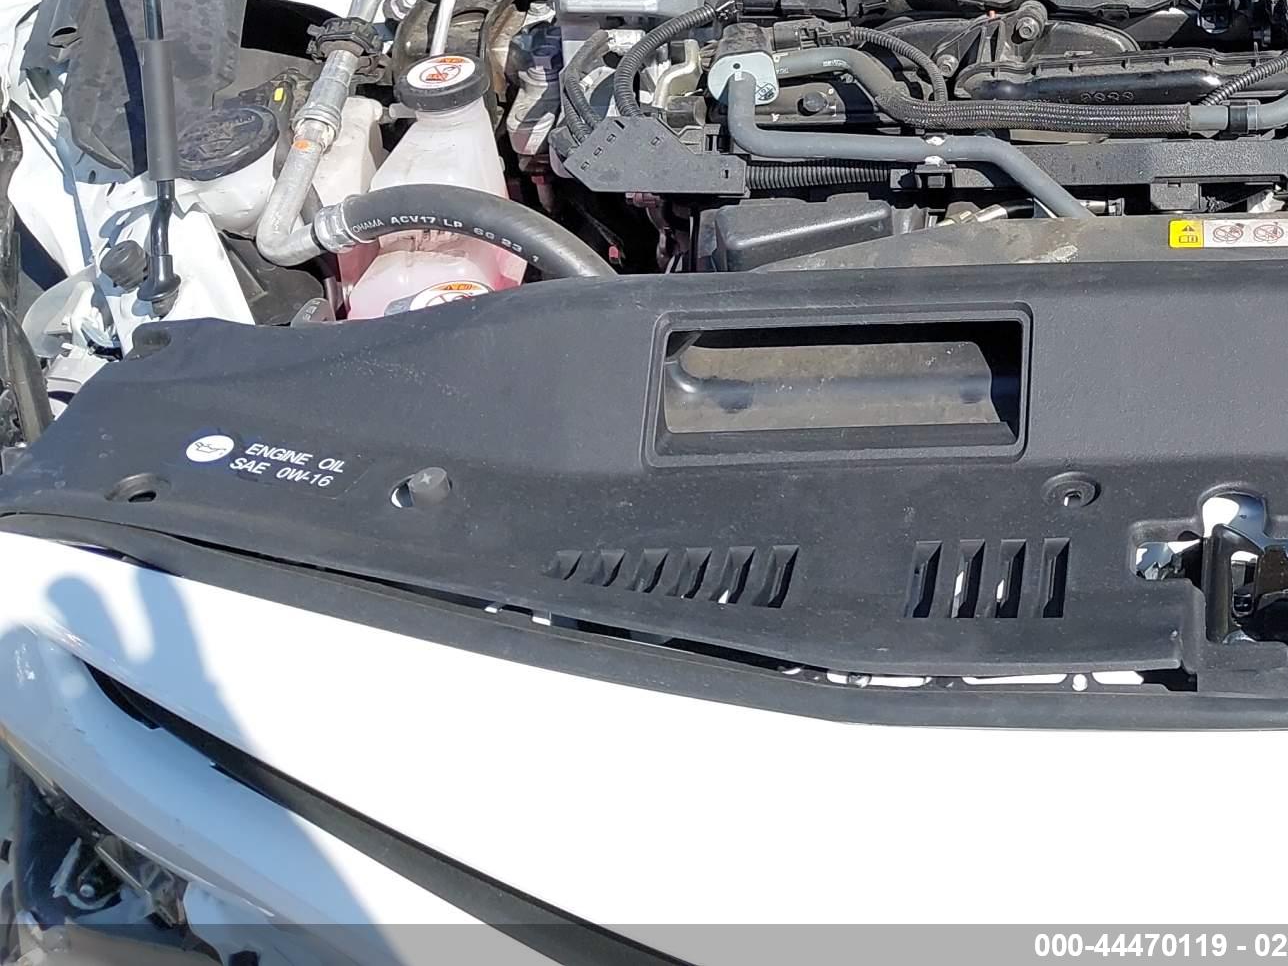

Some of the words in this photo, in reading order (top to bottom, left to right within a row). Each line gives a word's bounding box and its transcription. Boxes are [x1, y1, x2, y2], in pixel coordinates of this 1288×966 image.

[351, 218, 385, 233] OHAMA
[390, 215, 437, 226] ACV17
[443, 219, 463, 228] LP
[229, 457, 271, 475] SAE
[276, 467, 334, 487] 0W-16
[245, 442, 313, 466] ENGINE
[318, 458, 345, 473] OIL
